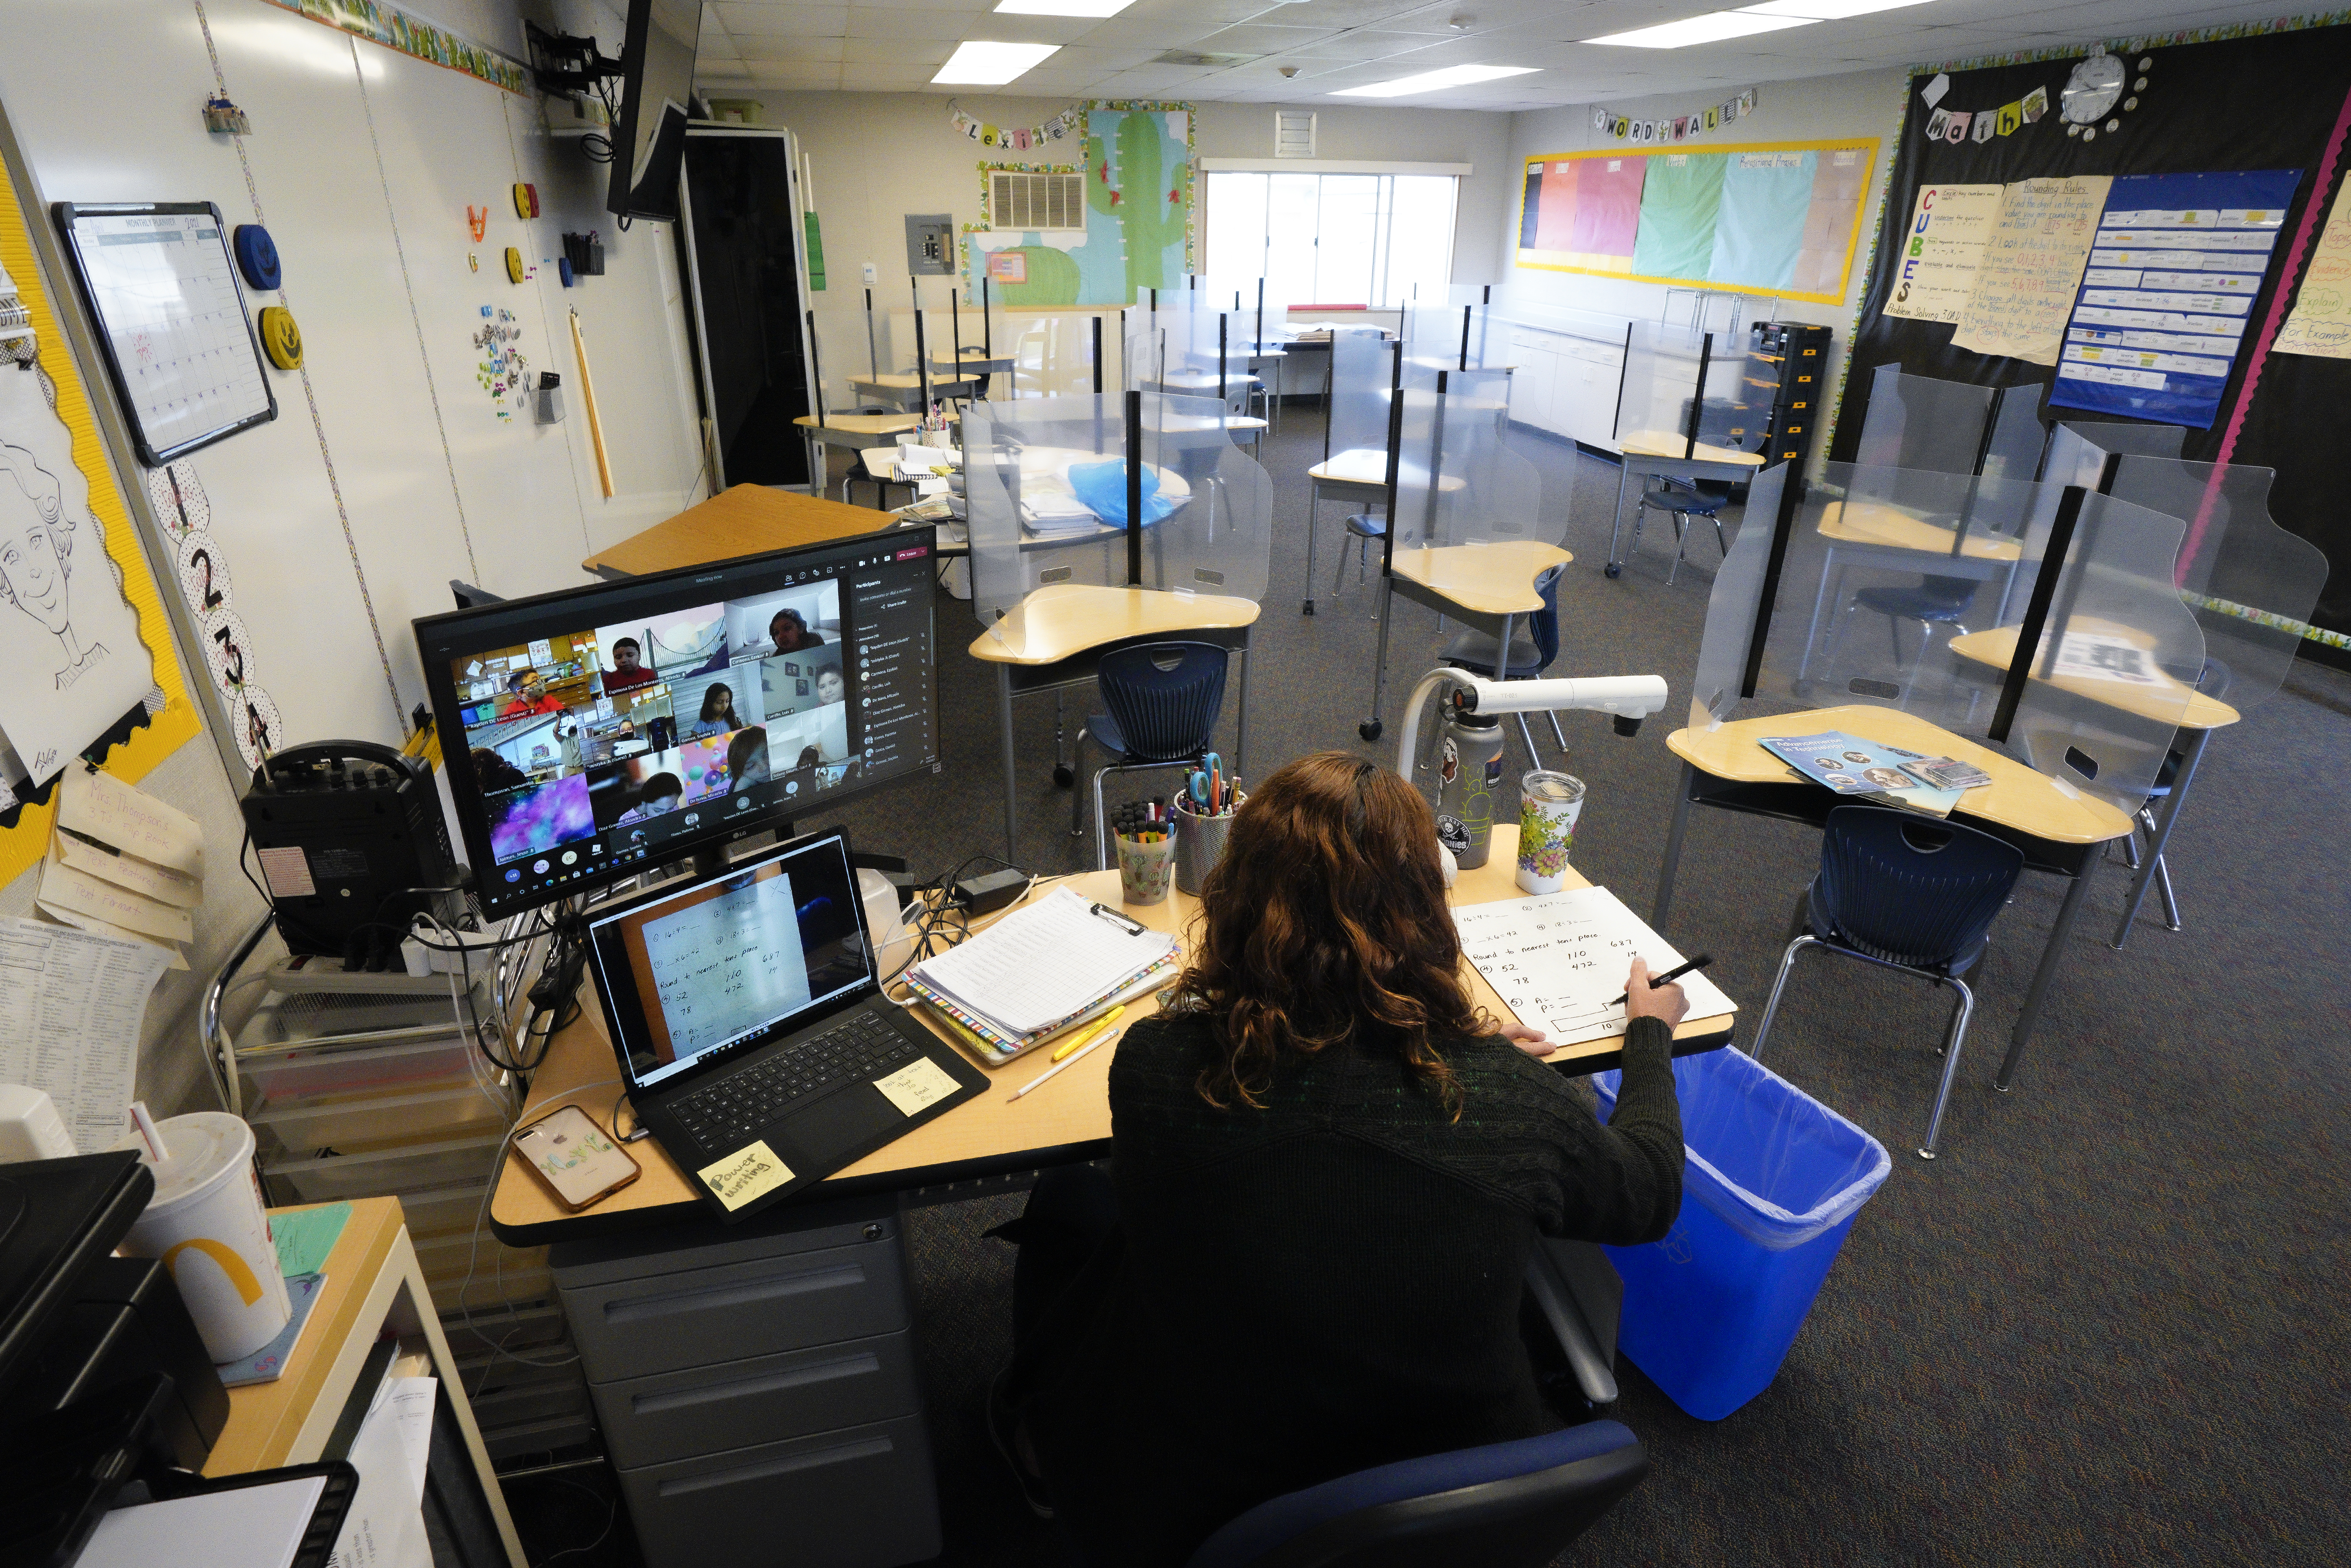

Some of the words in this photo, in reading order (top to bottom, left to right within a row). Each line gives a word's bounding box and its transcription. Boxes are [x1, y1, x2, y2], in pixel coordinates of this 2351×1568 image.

[1607, 119, 1652, 139] WORD
[1676, 105, 1731, 137] WALL
[1668, 155, 1684, 167] Verbs
[1741, 156, 1772, 168] Prepositional
[1777, 157, 1796, 167] Phrases
[2024, 181, 2059, 196] Rounding
[2064, 181, 2085, 193] Rules
[126, 219, 151, 228] MONTHLY
[152, 218, 175, 227] PLANNER
[2300, 292, 2338, 308] Explain
[1887, 303, 1911, 316] Problem
[1915, 307, 1938, 320] Solving
[2283, 324, 2302, 336] For
[2307, 325, 2349, 341] Example
[191, 548, 222, 608] 2
[856, 580, 880, 589] Participants
[214, 626, 243, 684] 3
[609, 687, 627, 695] Espinosa
[643, 678, 664, 687] Monteros,
[666, 673, 680, 681] Alfredo
[1776, 738, 1844, 747] Advancements
[91, 780, 111, 805] Mrs.
[484, 786, 510, 798] Thompson,
[511, 781, 534, 791] Samantha
[1460, 826, 1469, 837] DIE
[145, 832, 169, 850] Book
[1610, 939, 1632, 948] 687
[763, 951, 779, 962] 687
[1473, 952, 1497, 960] Round
[1522, 943, 1549, 952] nearest
[1568, 950, 1586, 959] 110
[1502, 964, 1519, 972] 52
[1572, 961, 1597, 971] 472
[660, 978, 677, 989] Round
[696, 962, 718, 976] nearest
[726, 969, 741, 983] 110
[724, 983, 744, 995] 472
[676, 992, 688, 1001] 52
[680, 1006, 691, 1016] 78
[907, 1064, 923, 1074] text
[914, 1087, 930, 1097] feel
[709, 1153, 756, 1192] Power
[725, 1163, 771, 1198] writing
